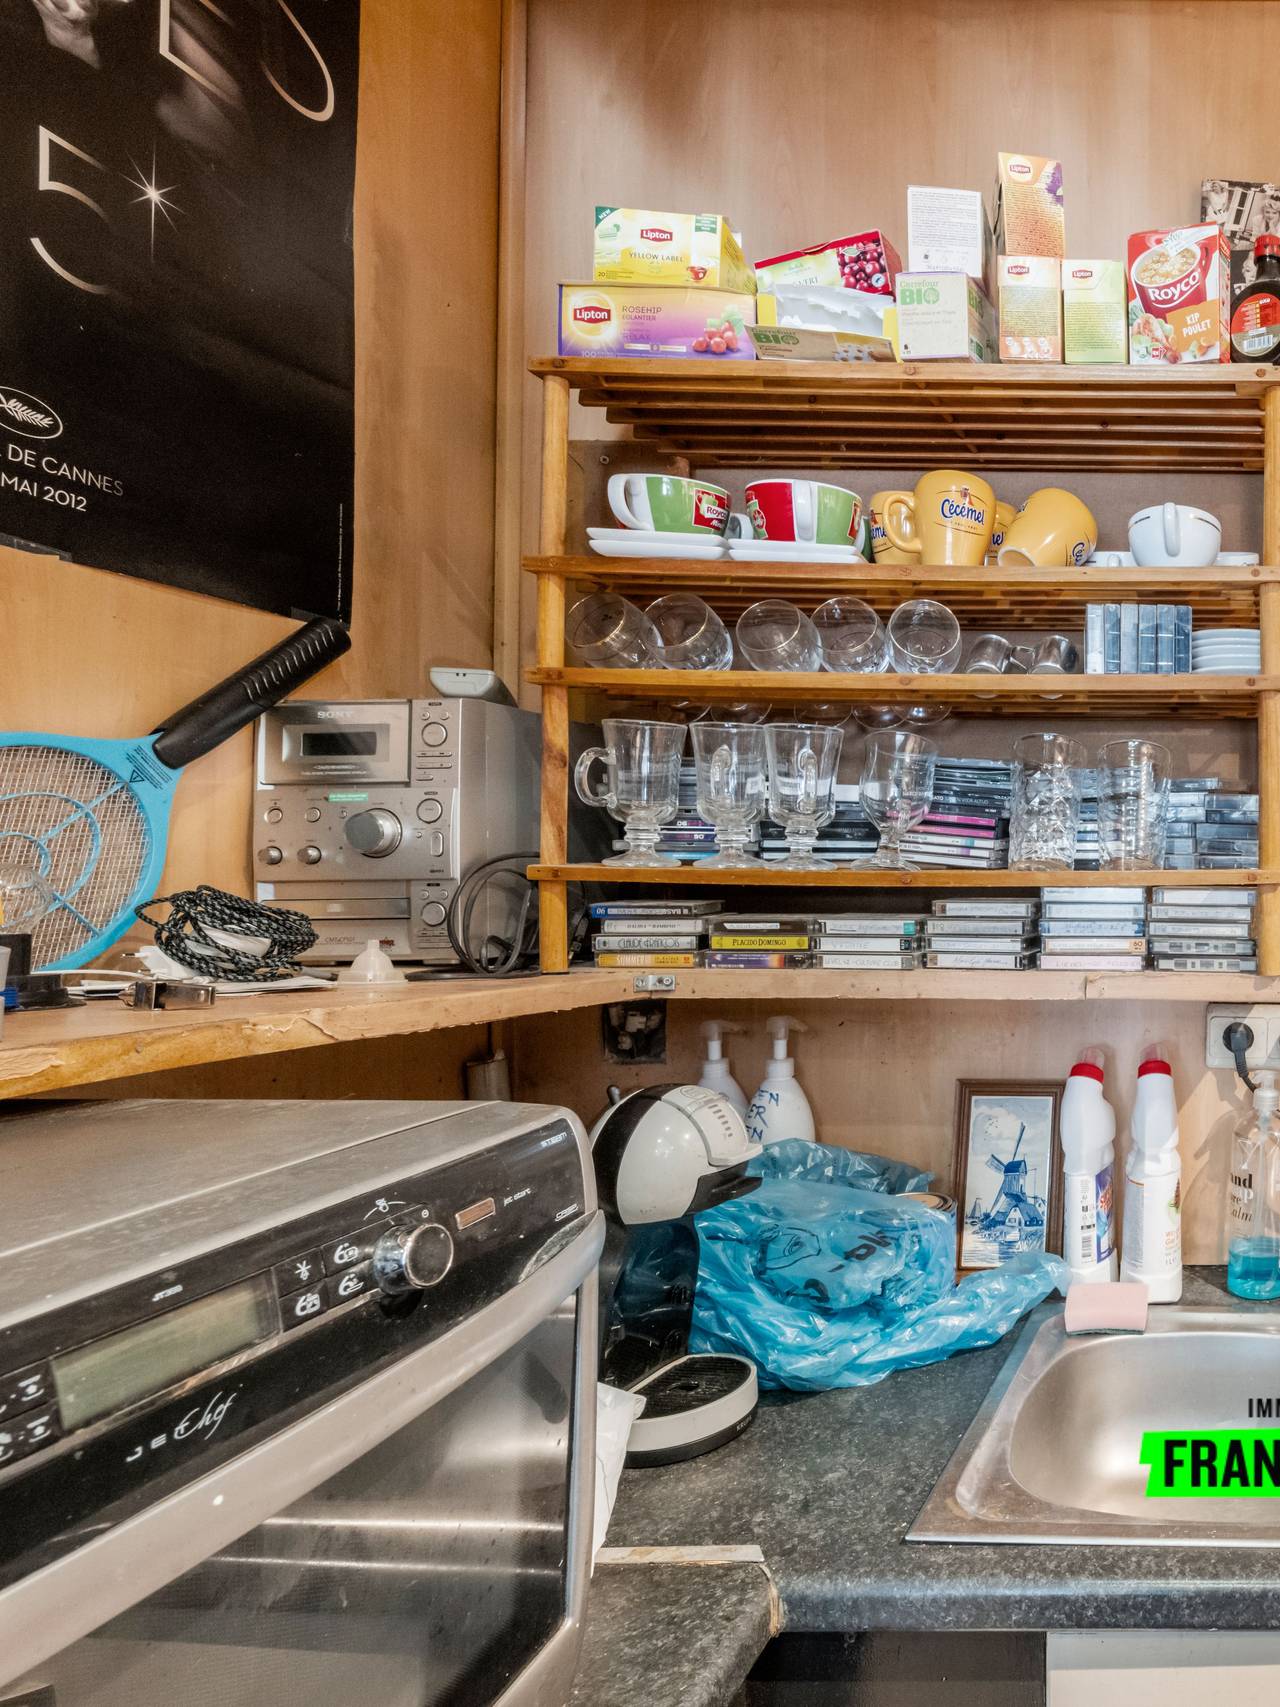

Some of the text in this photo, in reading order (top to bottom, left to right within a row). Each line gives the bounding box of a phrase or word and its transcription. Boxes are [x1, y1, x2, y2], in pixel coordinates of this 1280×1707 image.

[1011, 165, 1029, 173] Lipton
[598, 209, 611, 220] NEW
[643, 230, 671, 241] Lipton
[628, 251, 684, 263] YELLOW LABEL
[1009, 266, 1028, 274] Lipton
[1073, 271, 1092, 279] Lipton
[1149, 271, 1200, 300] Royco
[900, 287, 940, 305] BIO
[576, 309, 609, 321] Lipton
[622, 306, 662, 314] ROSEHIP
[1185, 312, 1200, 324] KIP
[1182, 319, 1212, 337] POULET
[753, 333, 800, 346] BIO
[8, 443, 124, 496] DE CANNES
[1, 472, 87, 512] MAI 2012
[941, 497, 985, 526] Cécémel
